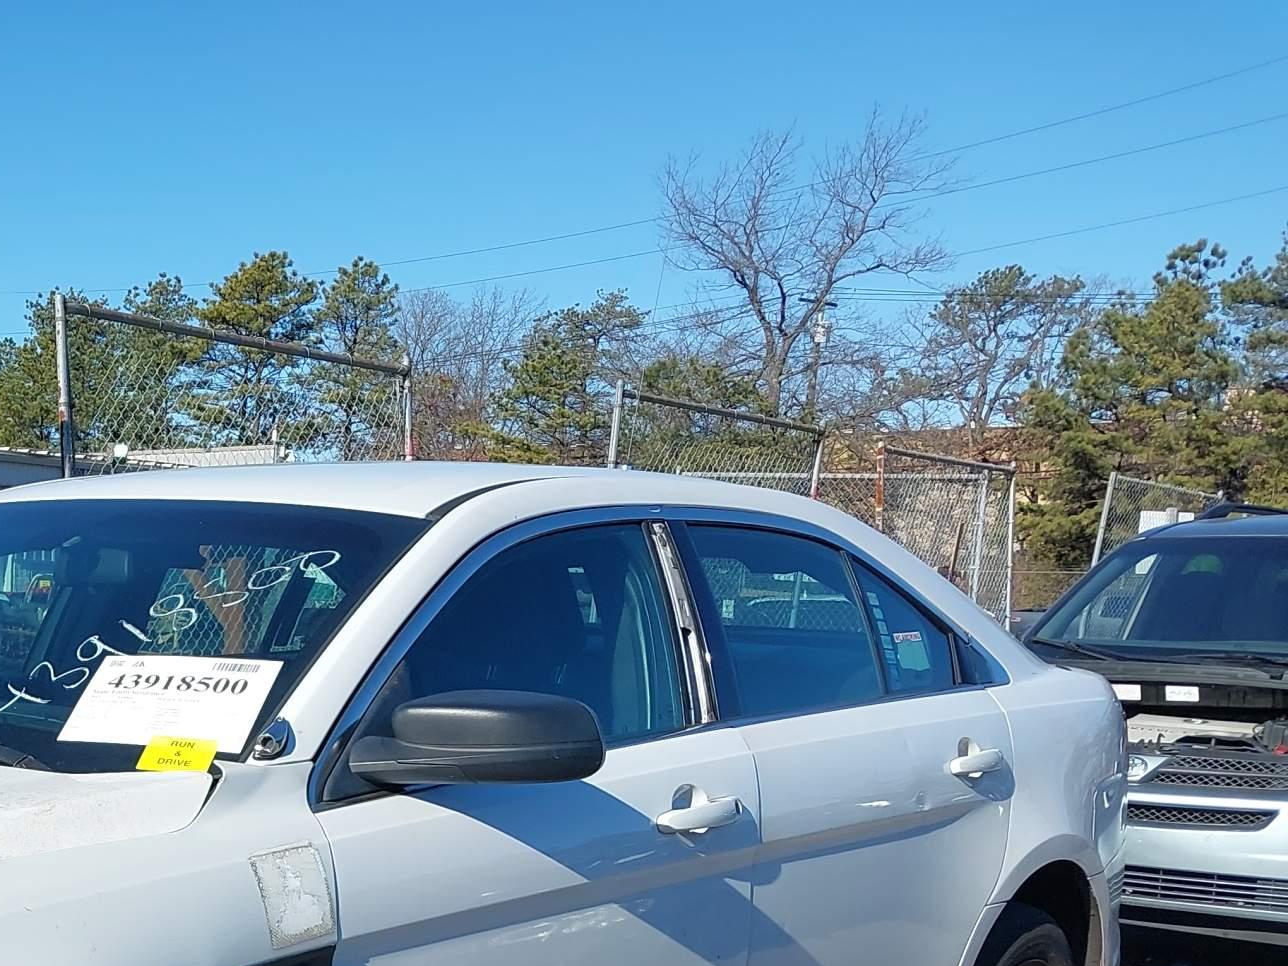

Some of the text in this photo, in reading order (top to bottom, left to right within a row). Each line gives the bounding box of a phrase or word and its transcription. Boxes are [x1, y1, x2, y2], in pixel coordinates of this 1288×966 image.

[107, 672, 249, 695] 43918500
[170, 740, 195, 749] RUN
[157, 758, 192, 768] DRIVE
